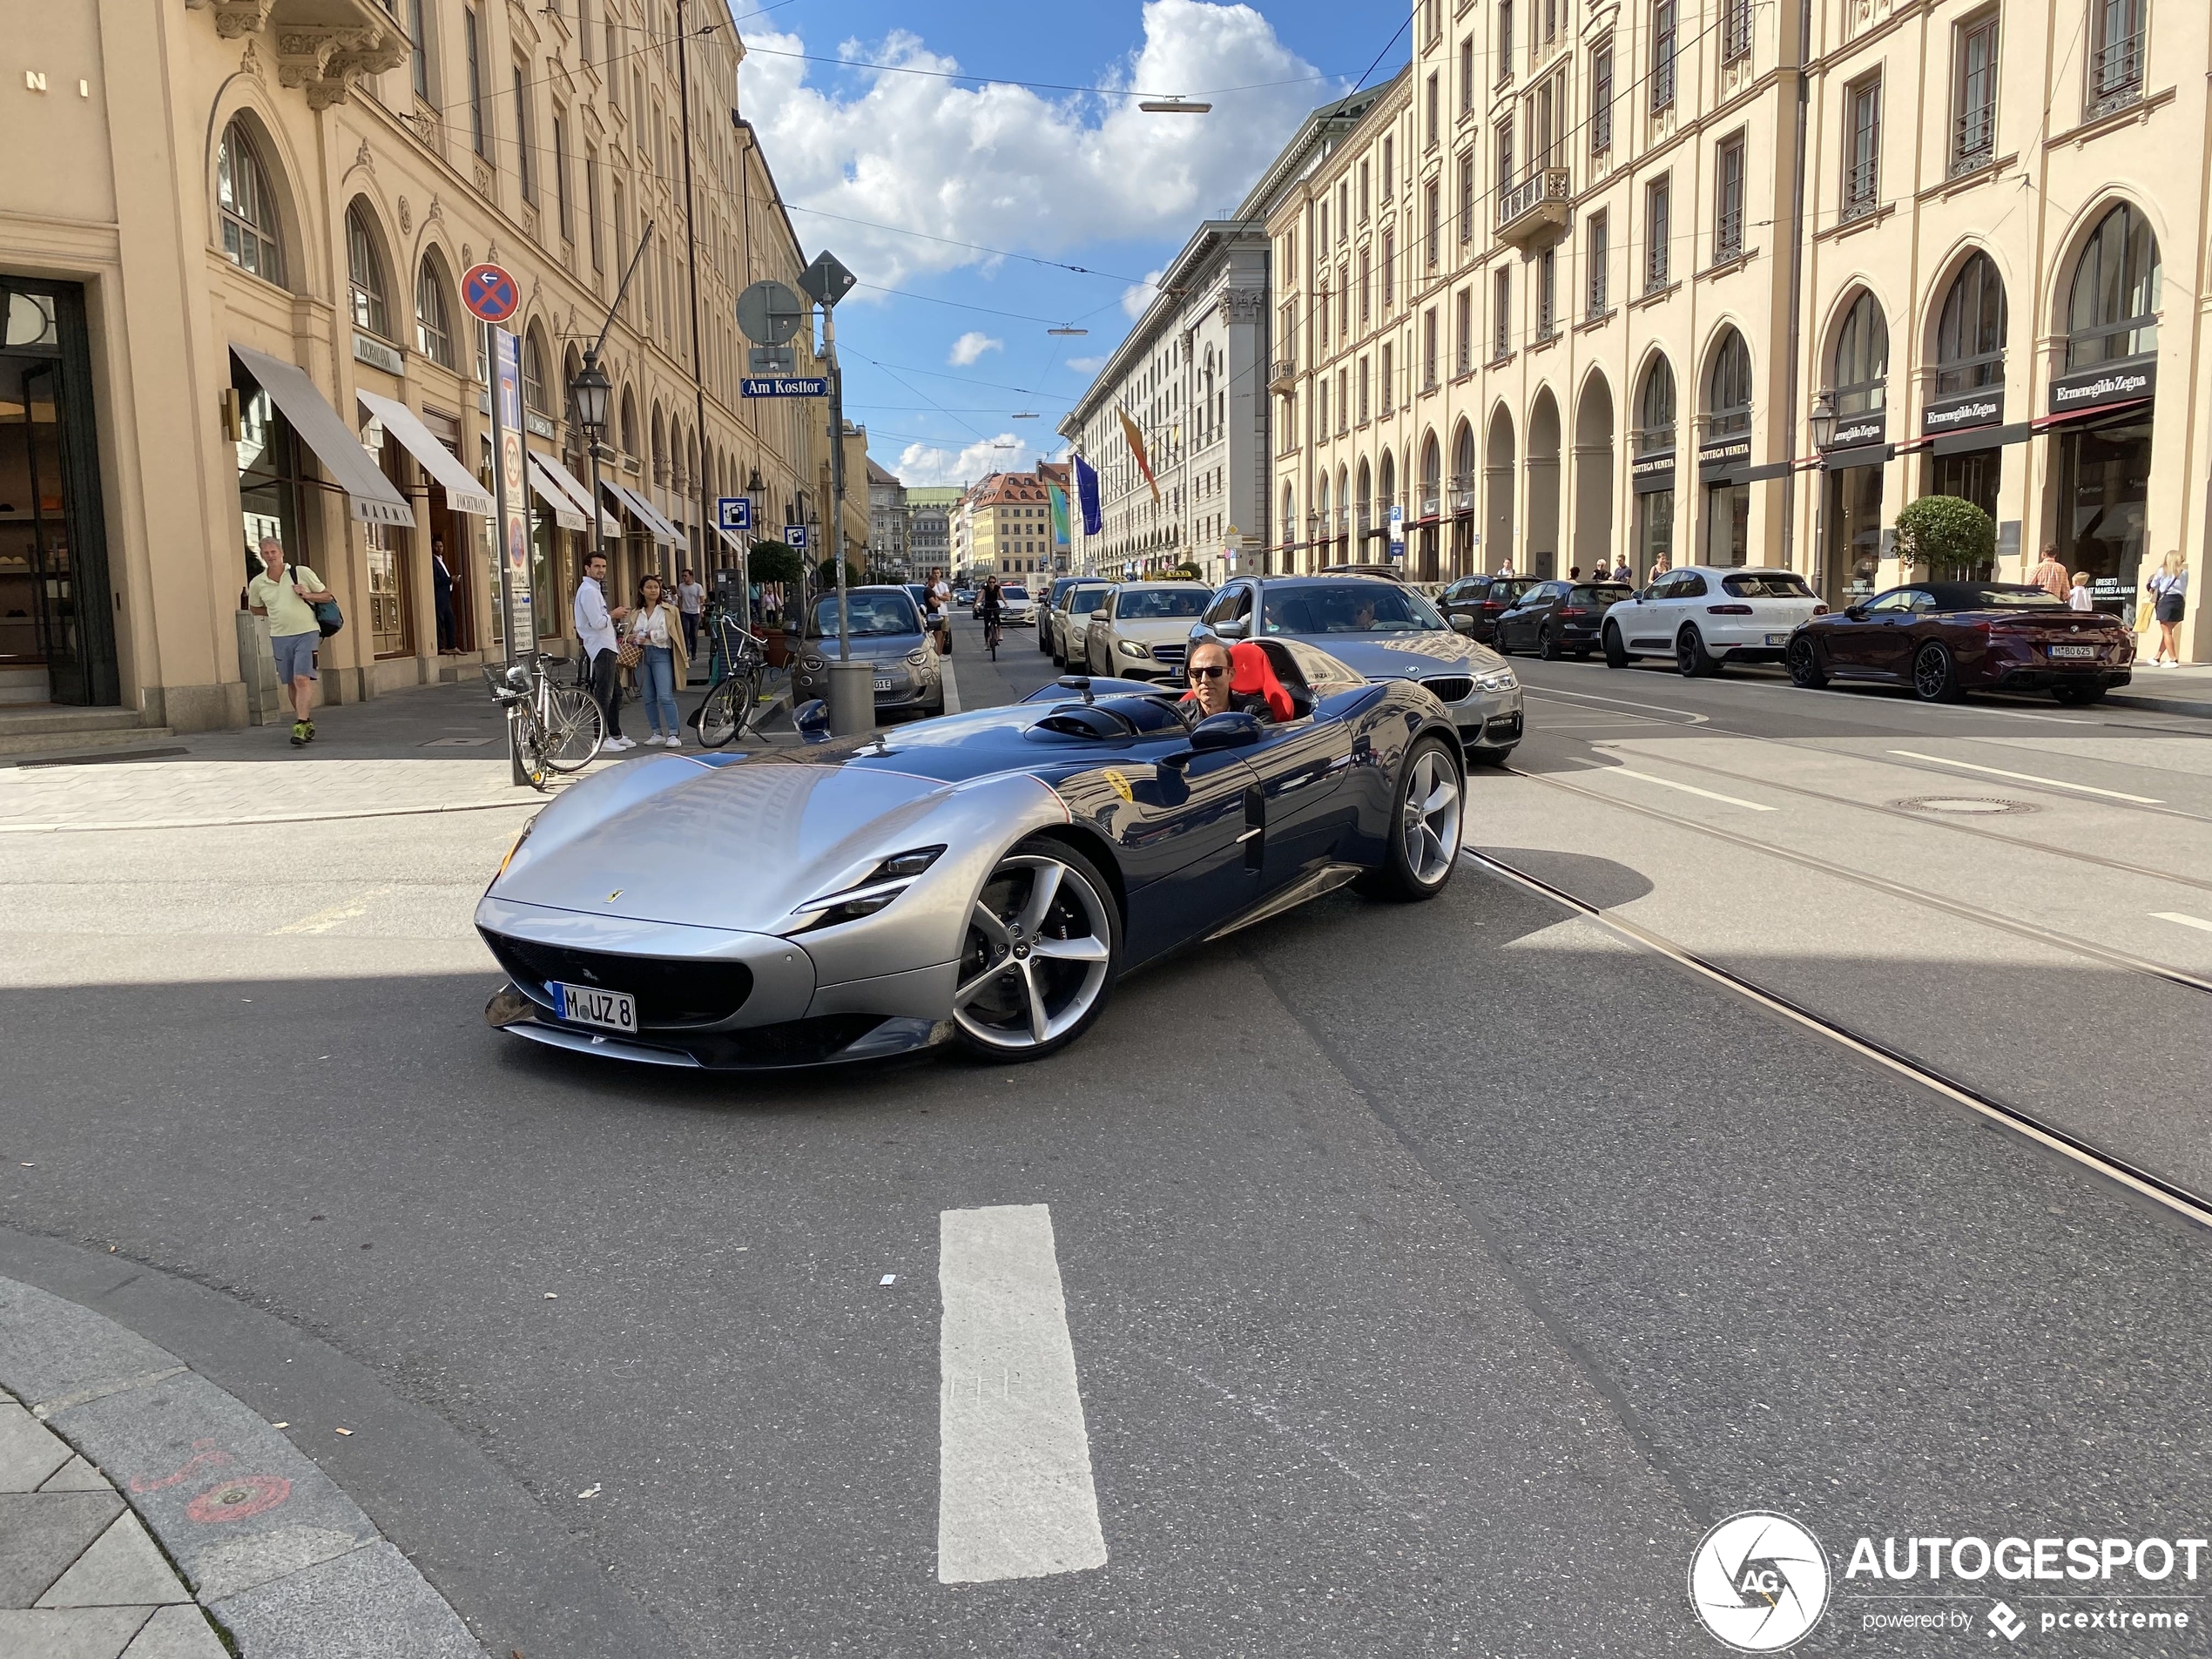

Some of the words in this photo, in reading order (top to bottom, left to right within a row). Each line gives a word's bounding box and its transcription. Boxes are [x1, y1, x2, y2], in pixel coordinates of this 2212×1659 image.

[748, 380, 771, 394] Am
[774, 380, 820, 394] Kosttor
[2056, 378, 2114, 401] Ermenegildo
[2114, 374, 2147, 392] Zegna
[1926, 406, 1973, 424] Ermenegildo
[1972, 402, 1997, 418] Zegna
[1834, 427, 1861, 442] enegildo
[1860, 424, 1880, 437] Zegna
[1698, 448, 1724, 461] BOTTEGA
[1724, 443, 1749, 456] VENETA
[508, 449, 517, 474] 30
[1632, 462, 1654, 474] BOTTEGA
[1654, 458, 1675, 470] VENETA
[455, 493, 488, 513] FOCHTMANN
[508, 490, 520, 503] ZONE
[361, 502, 408, 522] MARNI
[2094, 586, 2114, 595] MAKES
[2095, 577, 2117, 587] (RESET)
[565, 989, 579, 1017] M
[589, 994, 616, 1024] UZ
[619, 999, 631, 1027] 8
